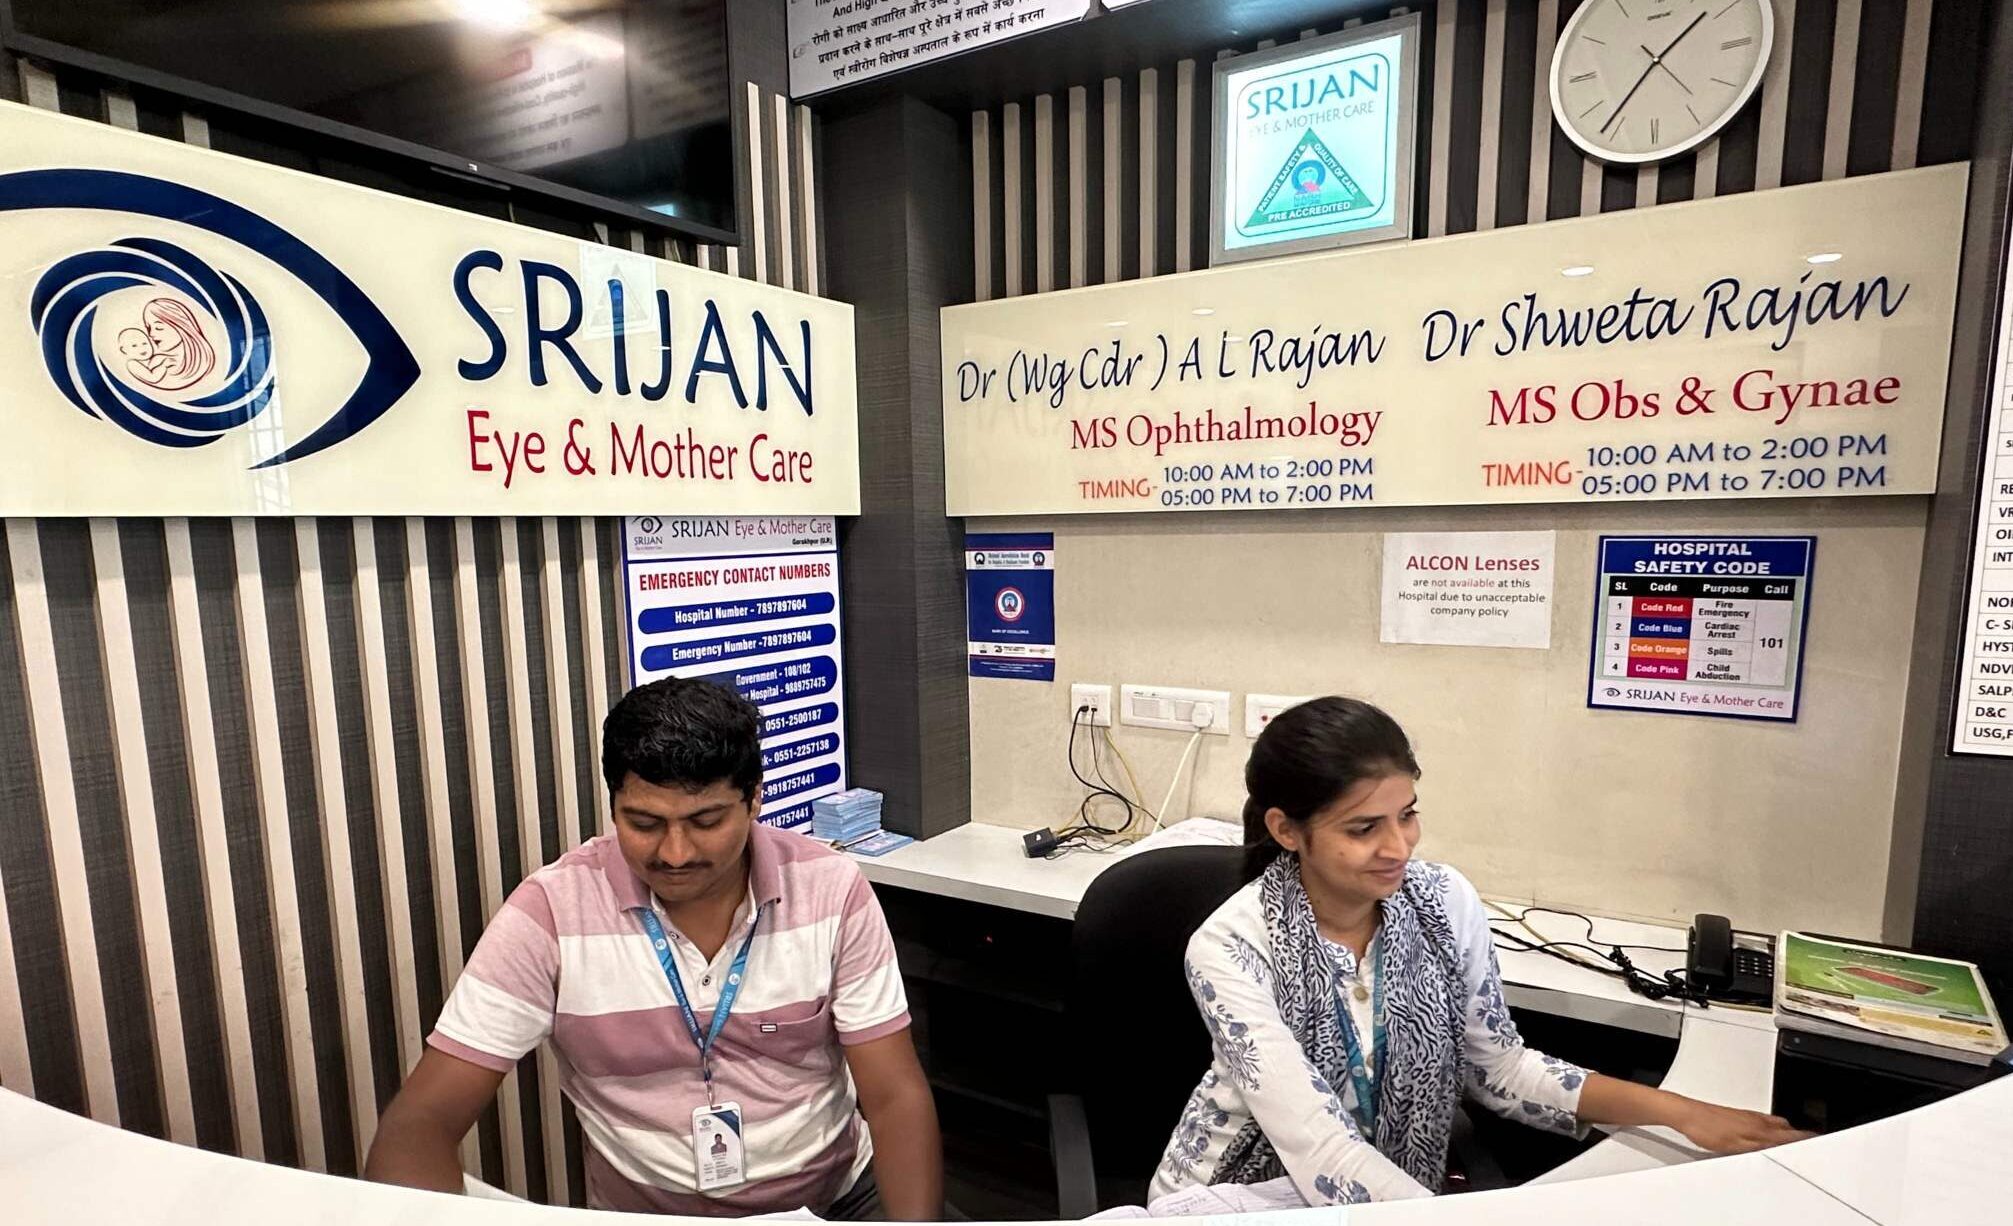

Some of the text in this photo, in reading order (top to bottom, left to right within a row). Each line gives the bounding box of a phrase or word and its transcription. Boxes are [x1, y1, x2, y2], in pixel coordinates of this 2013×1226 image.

[833, 3, 852, 18] And
[833, 26, 843, 38] को
[909, 0, 926, 14] और
[842, 41, 861, 55] करने
[864, 37, 872, 49] के
[954, 9, 963, 21] में
[952, 31, 961, 43] के
[983, 21, 991, 34] में
[1019, 8, 1045, 24] करना
[1246, 64, 1378, 120] SRIJAN
[1285, 108, 1341, 131] MOTHER
[1343, 101, 1374, 118] CARE
[1268, 211, 1287, 222] PRE
[1288, 201, 1351, 219] ACCREDITED
[1422, 269, 1911, 362] Dr Shweta Rajan
[453, 249, 813, 417] SRIJAN
[957, 360, 997, 403] Dr
[1007, 349, 1075, 408] (Wg
[1179, 336, 1201, 382] A
[1250, 324, 1386, 389] Rajan
[1486, 369, 1900, 426] MS Obs & Gynae
[1070, 401, 1383, 457] MS Ophthalmology
[467, 410, 813, 489] Eye & Mother Care
[1587, 434, 1887, 468] 10:00 AM to 2:00 PM
[1164, 458, 1373, 483] 10:00 AM to 2:00 PM
[1581, 466, 1886, 496] 05:00 PM to 7:00 PM
[1161, 483, 1373, 506] 05:00 PM to 7:00 PM
[672, 518, 832, 539] SRIJAN Eye & Mother Care
[634, 536, 663, 546] SRIJAN
[1653, 542, 1752, 556] HOSPITAL
[1406, 556, 1540, 571] ALCON Lenses
[1634, 560, 1771, 575] SAFETY CODE
[639, 563, 831, 591] EMERGENCY CONTACT NUMBERS
[1413, 577, 1531, 588] are not available at this
[1614, 581, 1789, 594] SL Code Purpose Call
[1398, 591, 1546, 605] Hospital due to unacceptable
[1641, 603, 1663, 612] Code
[1665, 603, 1683, 612] Red
[1715, 600, 1733, 609] Fire
[675, 606, 713, 624] Hospital
[715, 607, 748, 620] Number
[757, 598, 807, 615] 7897897604
[1430, 606, 1509, 618] company policy
[1698, 608, 1750, 619] Emergency
[1615, 623, 1683, 633] 2 Code Blue
[1705, 622, 1740, 631] Cardiac
[1707, 630, 1736, 639] Arrest
[672, 642, 722, 661] Emergency
[724, 638, 756, 654] Number
[1614, 637, 1784, 657] 3 Code Orange Spills 101
[736, 668, 777, 686] Government
[784, 662, 811, 678] 108/102
[1612, 663, 1679, 674] 4 Code Pink
[1695, 671, 1741, 681] Abduction
[1707, 663, 1730, 672] Child
[750, 685, 779, 701] Hospital
[1626, 689, 1784, 709] SRIJAN Eye & Mother Care
[765, 708, 822, 732] 0551-2500187
[1975, 706, 2007, 718] D&C
[774, 739, 829, 763] 0551-2257138
